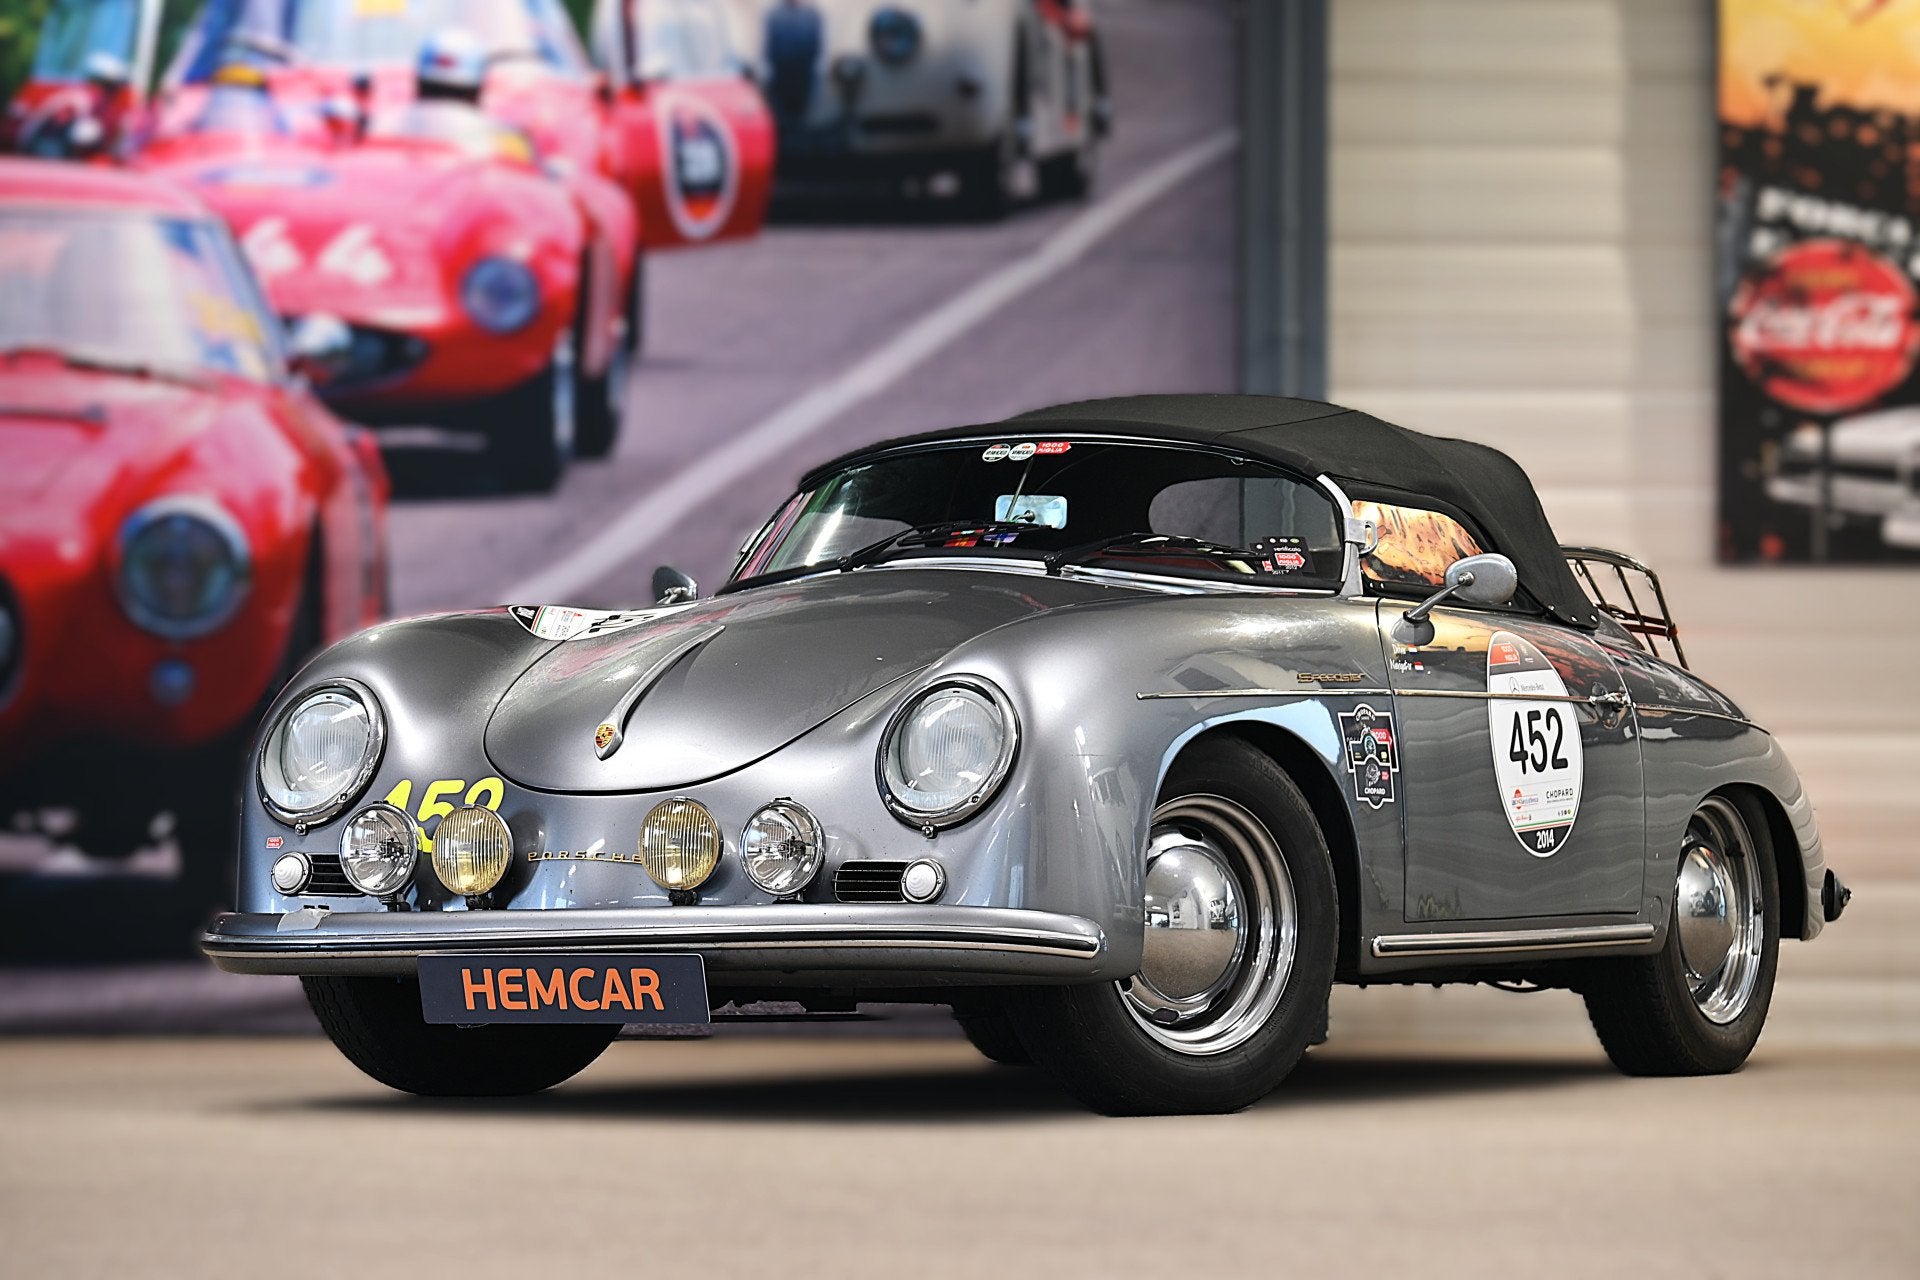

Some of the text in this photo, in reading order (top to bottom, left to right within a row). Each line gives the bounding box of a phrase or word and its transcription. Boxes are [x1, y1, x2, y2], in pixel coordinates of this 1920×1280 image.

[1509, 708, 1569, 775] 452
[1364, 787, 1386, 795] CHOPARD
[1545, 787, 1574, 799] CHOPARD
[1536, 829, 1555, 849] 2014
[461, 968, 665, 1010] HEMCAR
